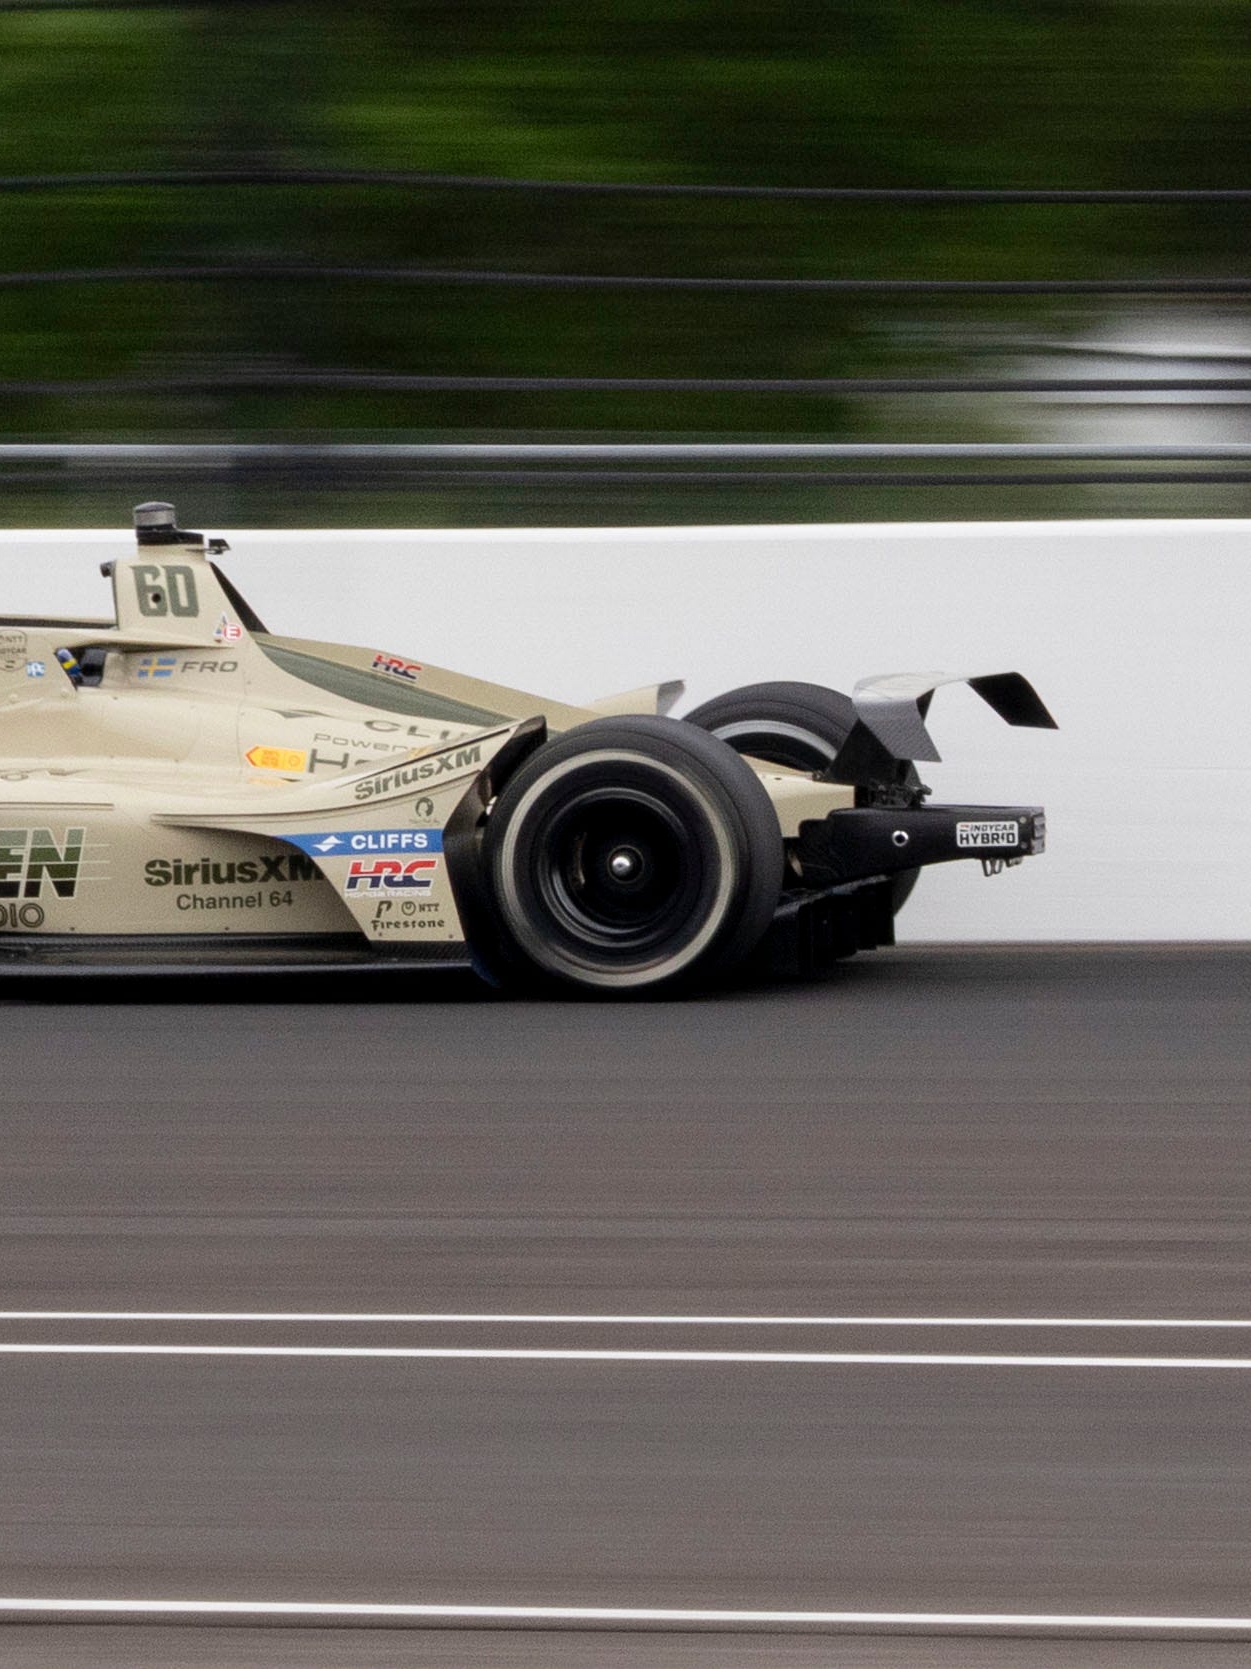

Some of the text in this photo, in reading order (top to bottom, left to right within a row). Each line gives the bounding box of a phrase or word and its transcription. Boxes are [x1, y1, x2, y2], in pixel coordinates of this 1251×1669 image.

[129, 565, 199, 618] 60
[180, 661, 239, 673] FRO
[372, 654, 423, 681] HRC
[354, 745, 481, 801] SiriusXM
[970, 823, 1015, 832] INDYCAR
[350, 833, 429, 850] CLIFFS
[144, 854, 324, 887] SiriusXM
[346, 859, 438, 890] HRC
[176, 890, 294, 911] Channel 64
[419, 902, 440, 912] NTT
[370, 919, 446, 932] Firestone
